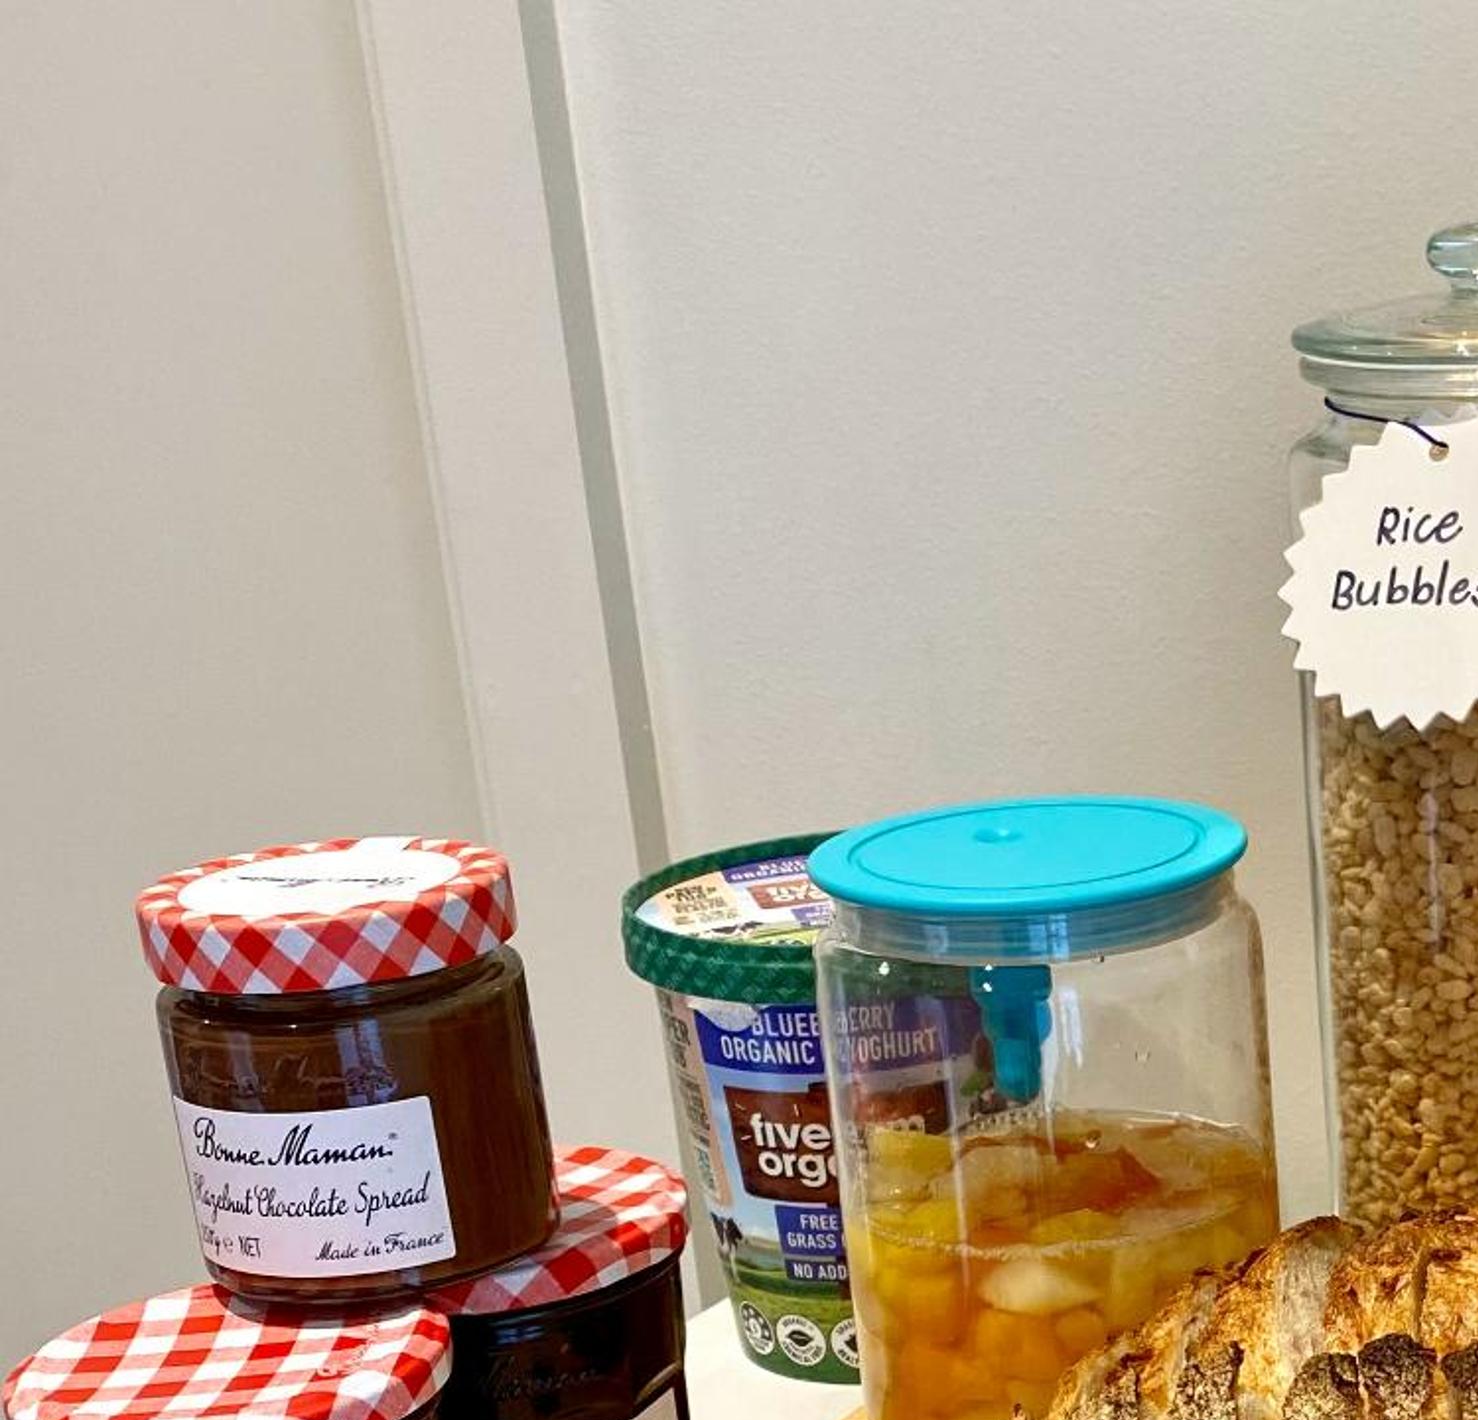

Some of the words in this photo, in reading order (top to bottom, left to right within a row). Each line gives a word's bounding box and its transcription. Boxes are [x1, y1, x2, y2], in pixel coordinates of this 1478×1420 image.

[1376, 505, 1464, 547] Rice
[720, 1036, 816, 1065] ORGANIC
[193, 1117, 265, 1163] Bonne
[268, 1123, 393, 1166] Maman
[749, 1111, 833, 1151] five
[254, 1184, 350, 1218] Chocolate
[354, 1170, 431, 1227] Spread
[799, 1213, 839, 1231] FREE
[315, 1242, 360, 1262] Made
[363, 1247, 382, 1258] in
[384, 1232, 445, 1254] France
[787, 1231, 837, 1250] GRASS
[793, 1262, 814, 1279] NO
